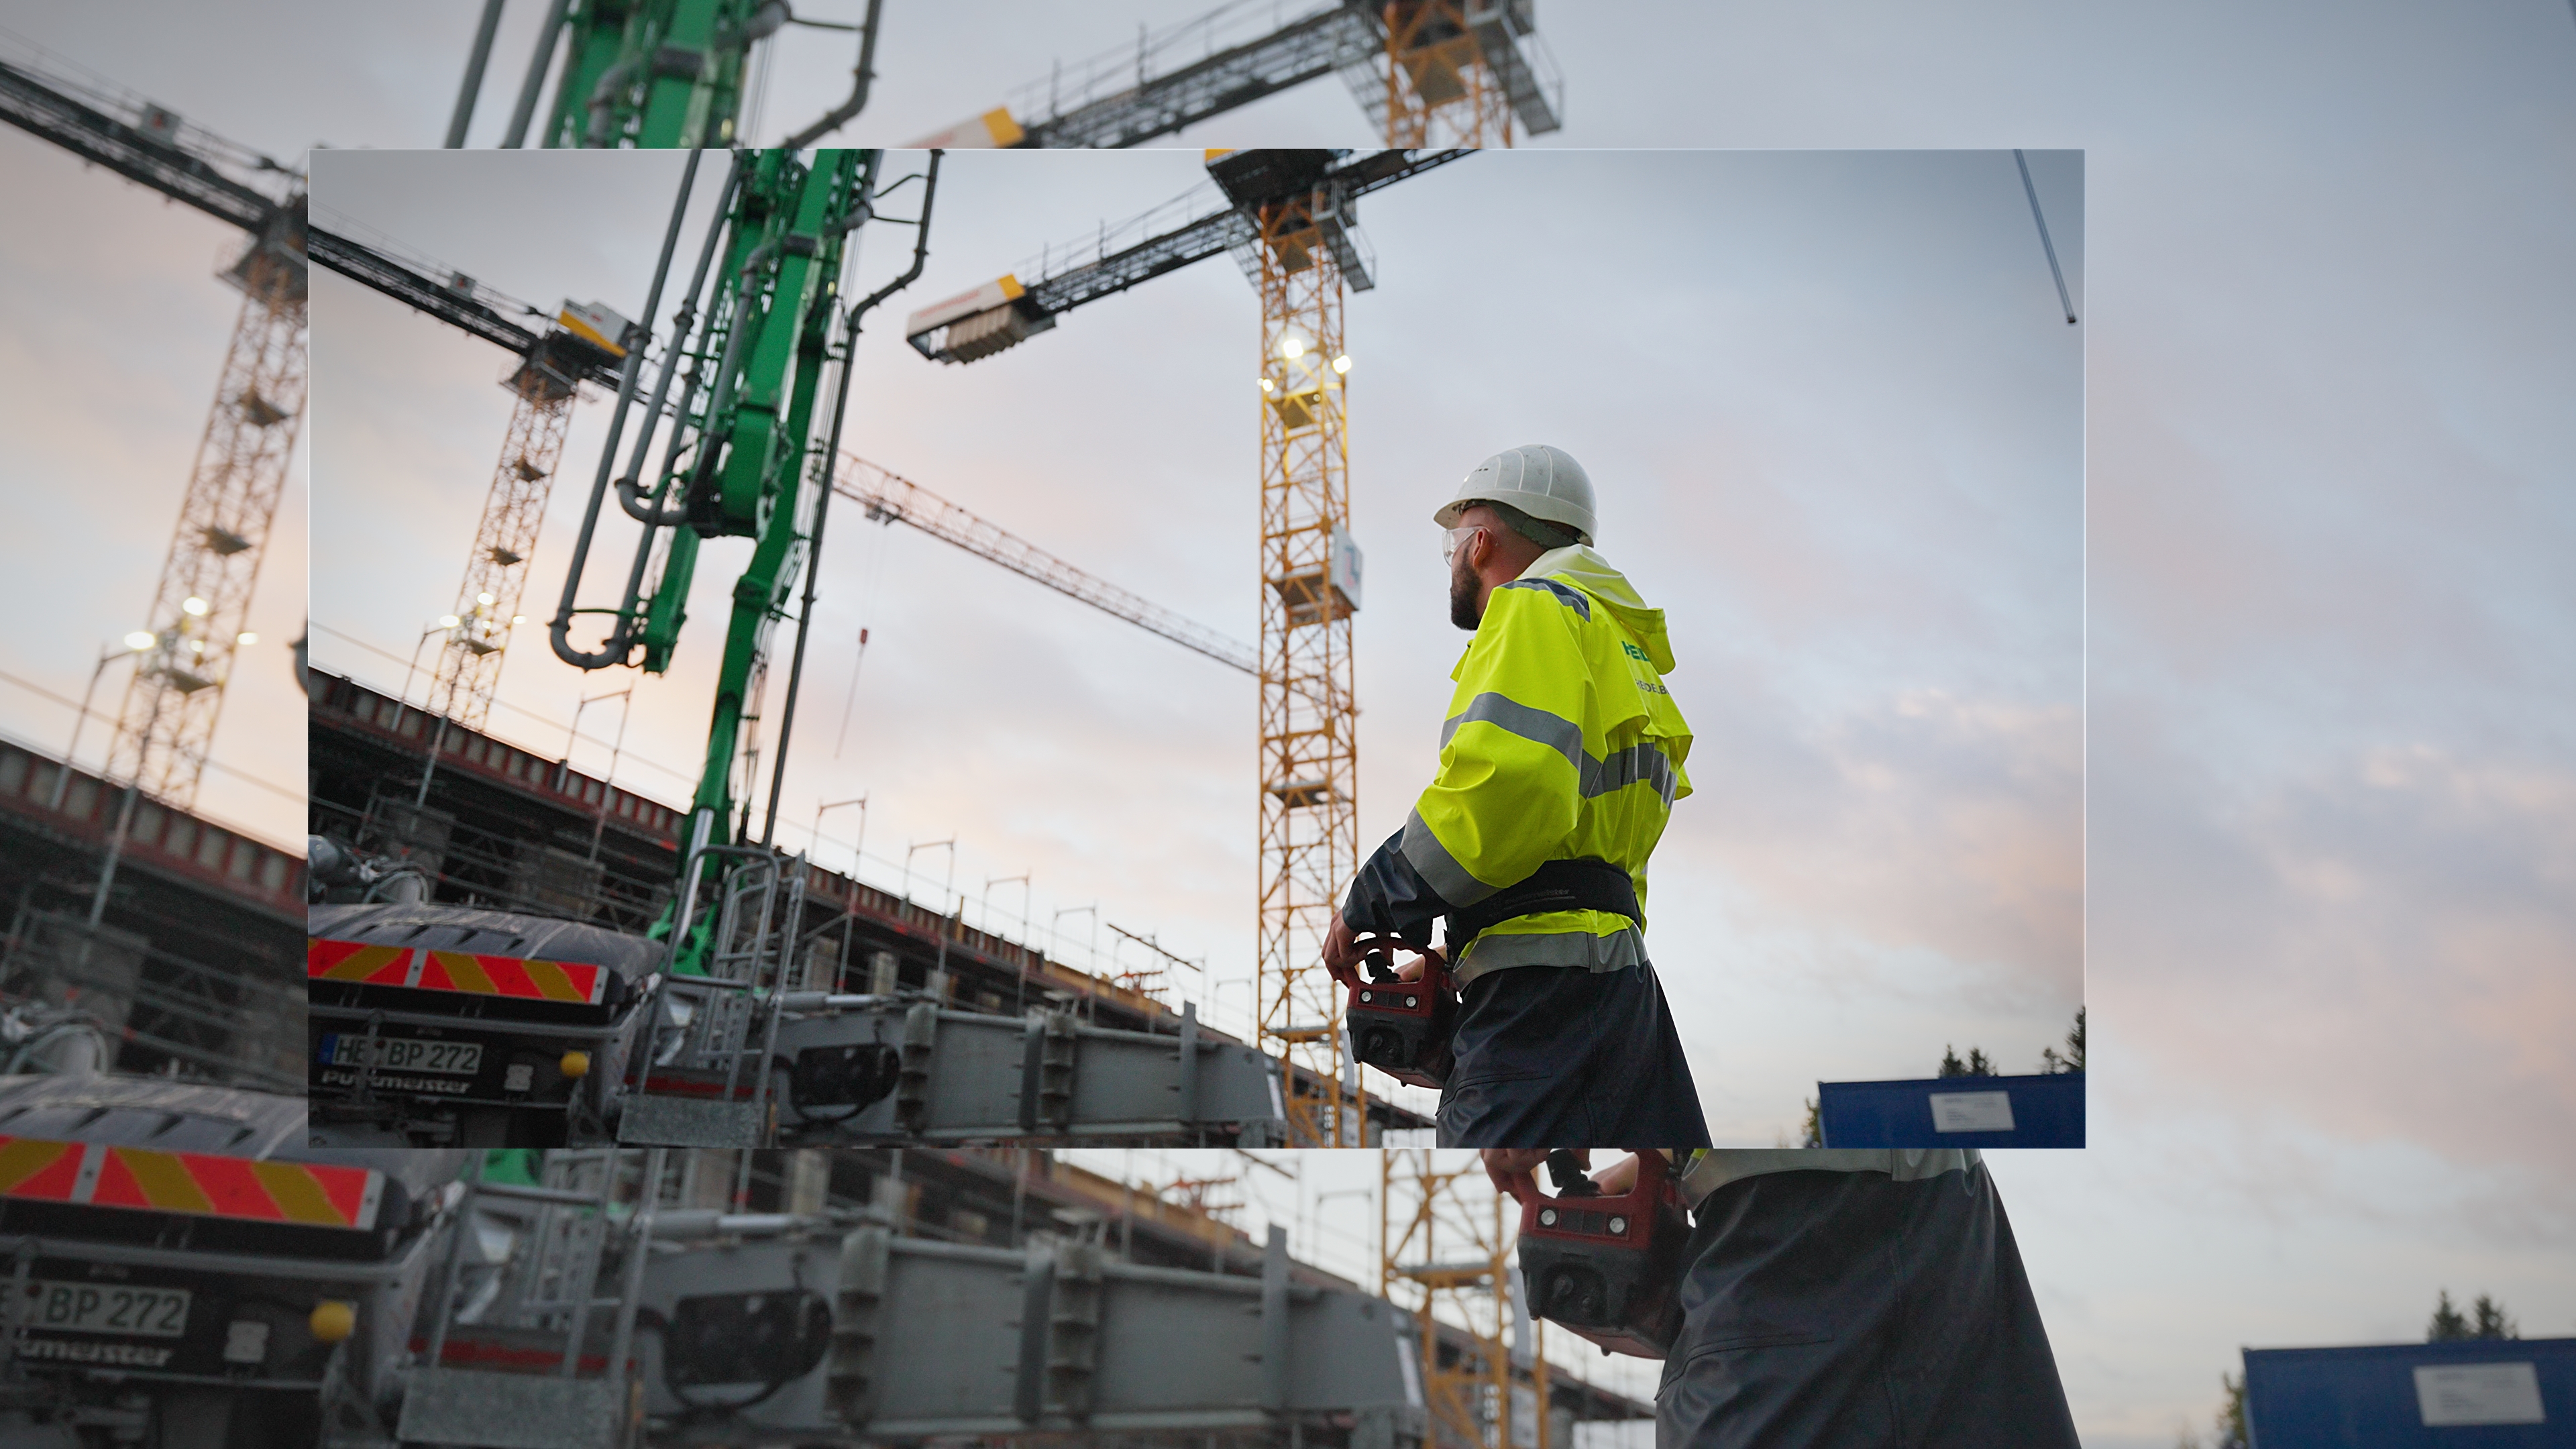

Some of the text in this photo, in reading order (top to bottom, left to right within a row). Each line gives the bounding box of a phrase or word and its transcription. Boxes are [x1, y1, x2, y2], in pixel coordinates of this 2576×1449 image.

[1635, 678, 1670, 695] HEIDELB
[335, 1037, 479, 1070] HE BP 272
[45, 1285, 101, 1324] BP
[106, 1290, 184, 1330] 272
